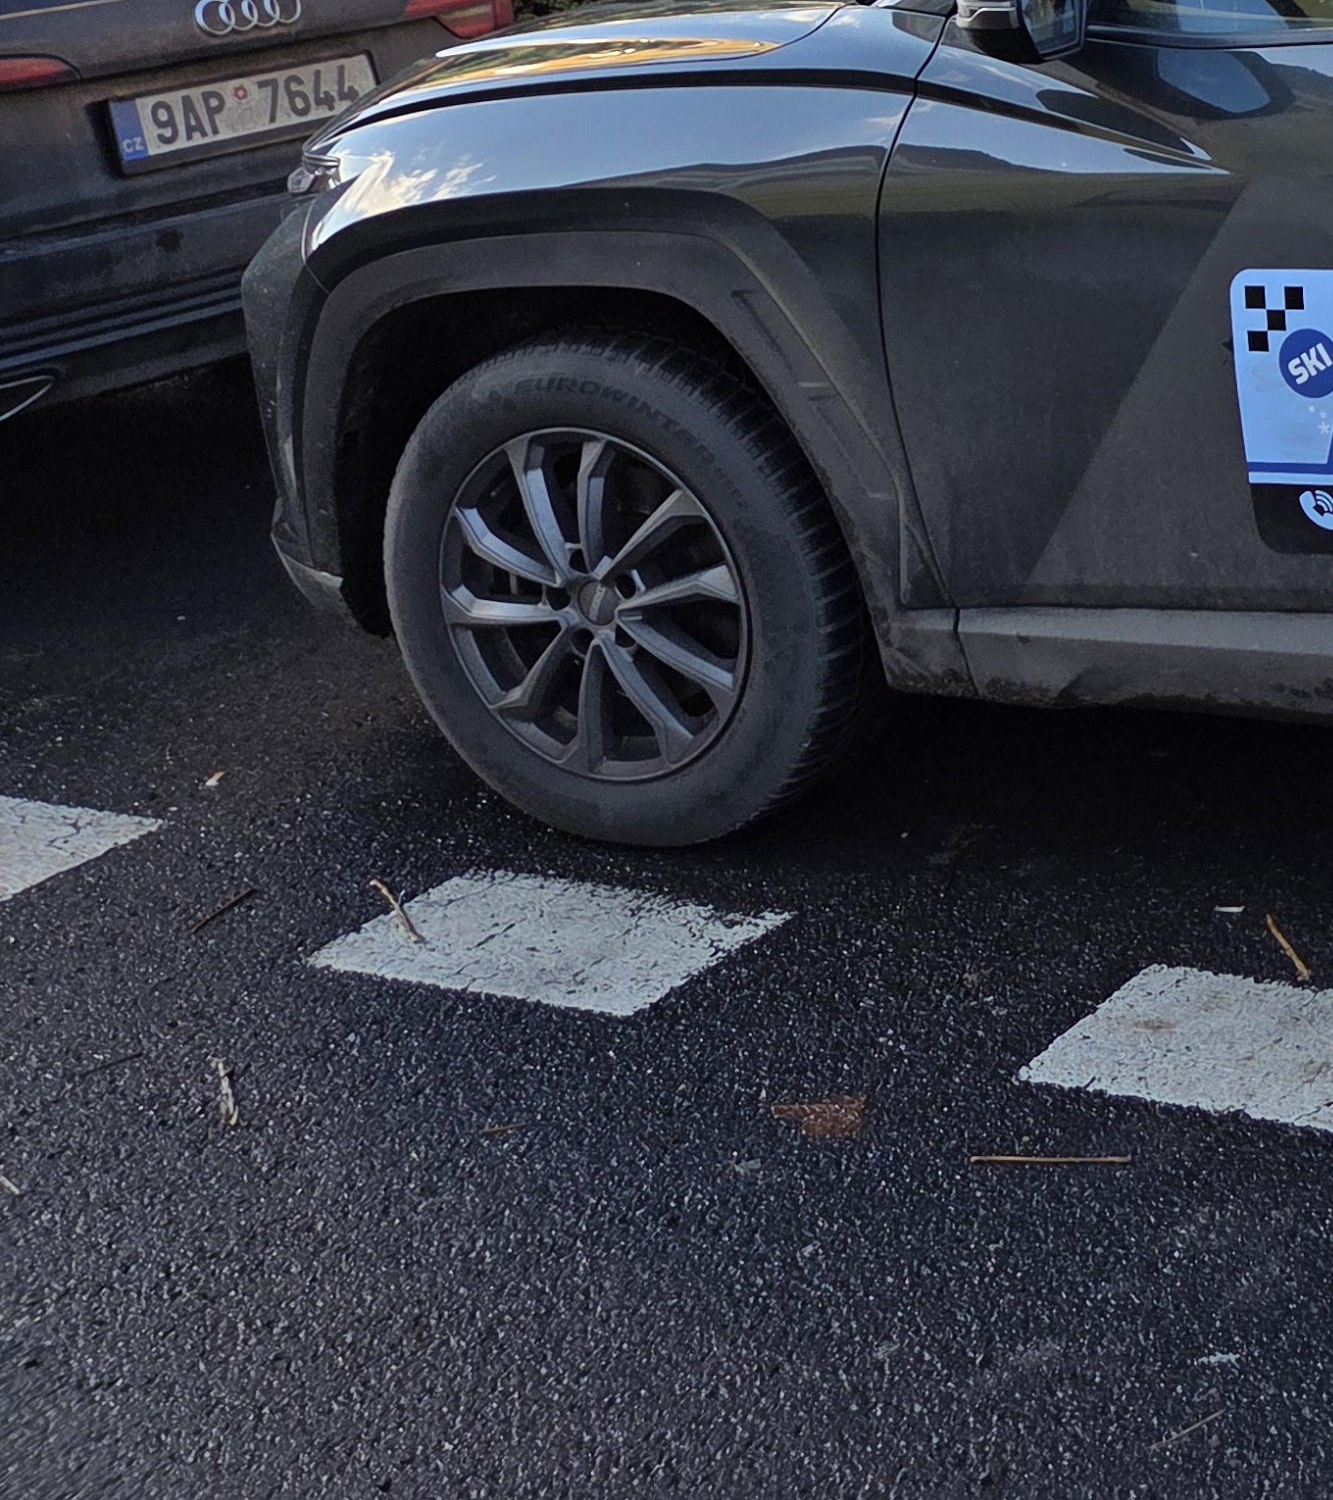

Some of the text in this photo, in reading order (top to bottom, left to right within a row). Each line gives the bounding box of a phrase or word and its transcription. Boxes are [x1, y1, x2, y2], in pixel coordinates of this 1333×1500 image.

[150, 64, 360, 145] 9AP 7644
[121, 136, 145, 152] CZ
[1286, 342, 1333, 385] SKI
